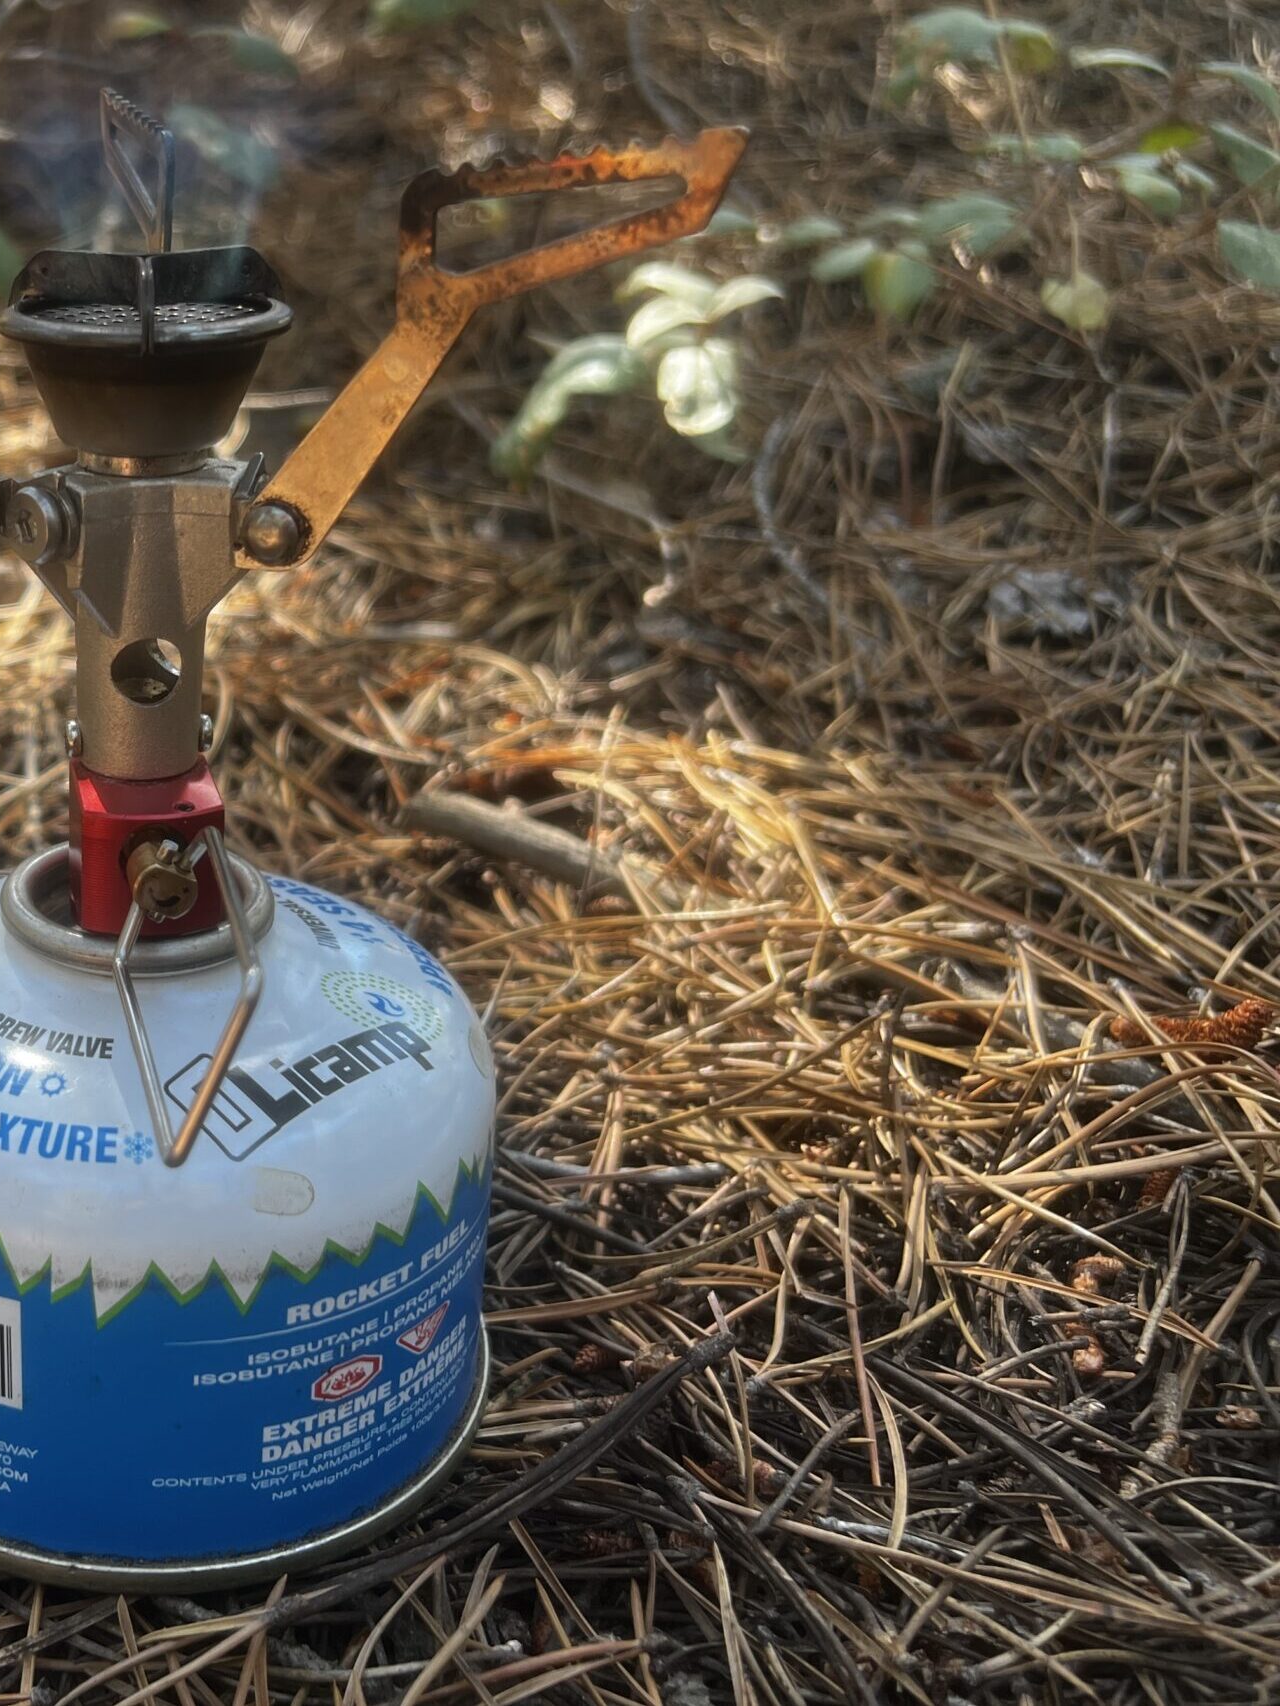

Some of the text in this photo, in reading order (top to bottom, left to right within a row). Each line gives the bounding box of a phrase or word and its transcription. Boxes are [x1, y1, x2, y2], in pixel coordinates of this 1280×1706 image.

[46, 1030, 115, 1060] VALVE
[286, 1219, 469, 1326] ROCKET FUEL
[192, 1350, 334, 1387] ISOBUTANE
[351, 1296, 438, 1352] PROPANE
[247, 1318, 379, 1366] ISOBUTANE
[394, 1255, 464, 1319] PROPANE
[262, 1380, 392, 1444] EXTREME
[399, 1314, 468, 1389] DANGER
[151, 1471, 247, 1488] CONTENTS
[252, 1458, 309, 1480] UNDER
[313, 1422, 388, 1465] PRESSURE
[250, 1471, 288, 1493] VERY
[292, 1443, 373, 1482] FLAMMABLE
[261, 1412, 376, 1464] DANGER
[271, 1487, 298, 1501] Net
[301, 1455, 375, 1498] Weight/Net
